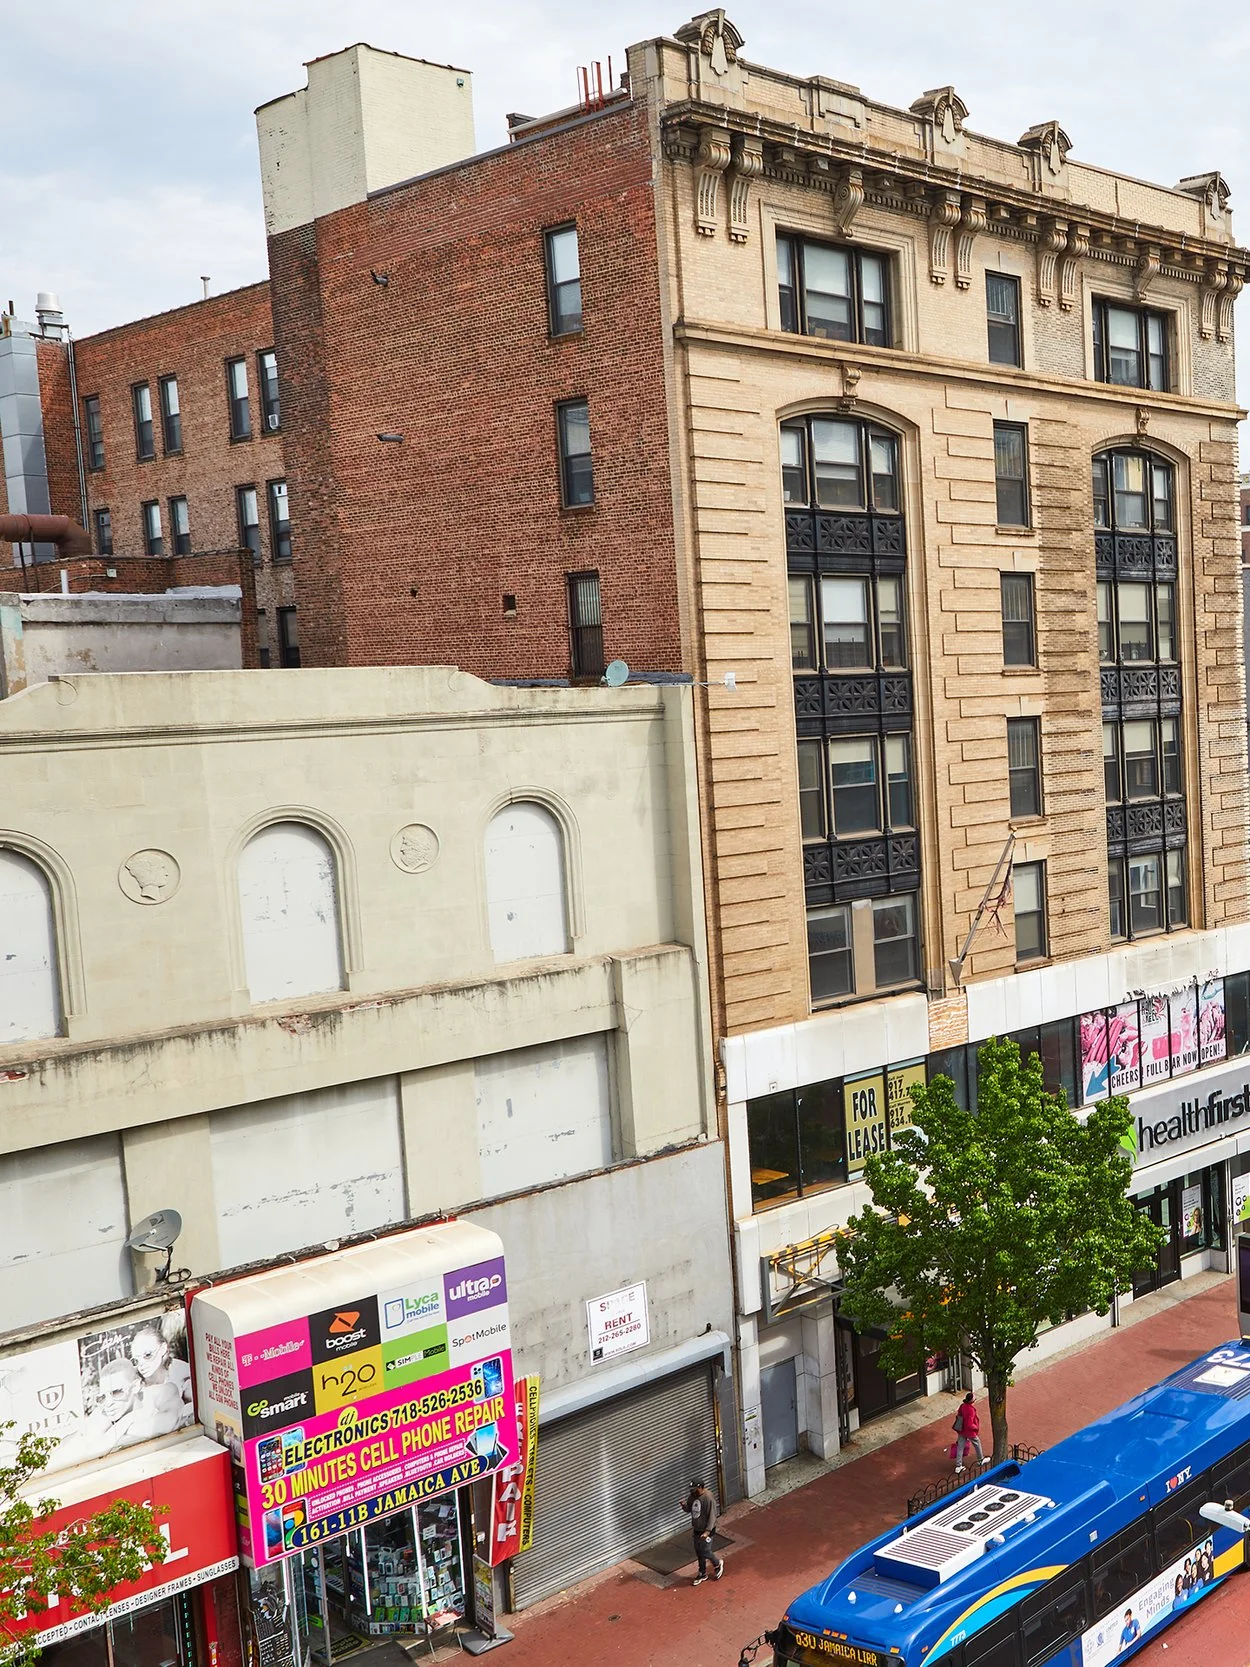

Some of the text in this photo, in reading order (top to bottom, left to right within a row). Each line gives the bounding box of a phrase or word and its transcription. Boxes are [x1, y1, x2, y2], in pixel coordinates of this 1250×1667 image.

[1146, 1062, 1163, 1077] FULL
[1164, 1056, 1181, 1070] BAR
[1182, 1050, 1198, 1065] NOW
[888, 1079, 903, 1092] 917
[852, 1087, 878, 1123] FOR
[889, 1106, 904, 1119] 917
[847, 1122, 885, 1161] LEASE
[405, 1292, 439, 1310] Lyca
[449, 1277, 491, 1301] ultra
[467, 1289, 491, 1302] mobile
[406, 1303, 440, 1319] mobile
[604, 1312, 633, 1330] RENT
[325, 1327, 367, 1350] boost
[598, 1323, 642, 1344] 212-265-2280
[335, 1341, 358, 1352] mobile
[28, 1409, 80, 1433] DITA
[284, 1379, 482, 1467] ELECTRONICS 718-526-2536
[261, 1397, 506, 1509] 30 MINUTES CELL PHONE REPAIR
[1177, 1465, 1192, 1486] NY
[300, 1458, 480, 1545] 161-11B JAMAICA AVE
[521, 1494, 534, 1546] COMPUTERS
[73, 1612, 104, 1632] CONTACT
[105, 1603, 130, 1618] LENSES
[135, 1588, 167, 1608] DESIGNER
[167, 1577, 193, 1597] FRAMES
[196, 1559, 236, 1583] SUNGLASSES
[1138, 1577, 1175, 1611] Engaging
[1146, 1595, 1170, 1619] Minds
[950, 1630, 966, 1647] 7773
[818, 1638, 856, 1661] JAMAICA
[857, 1651, 878, 1667] LIRR
